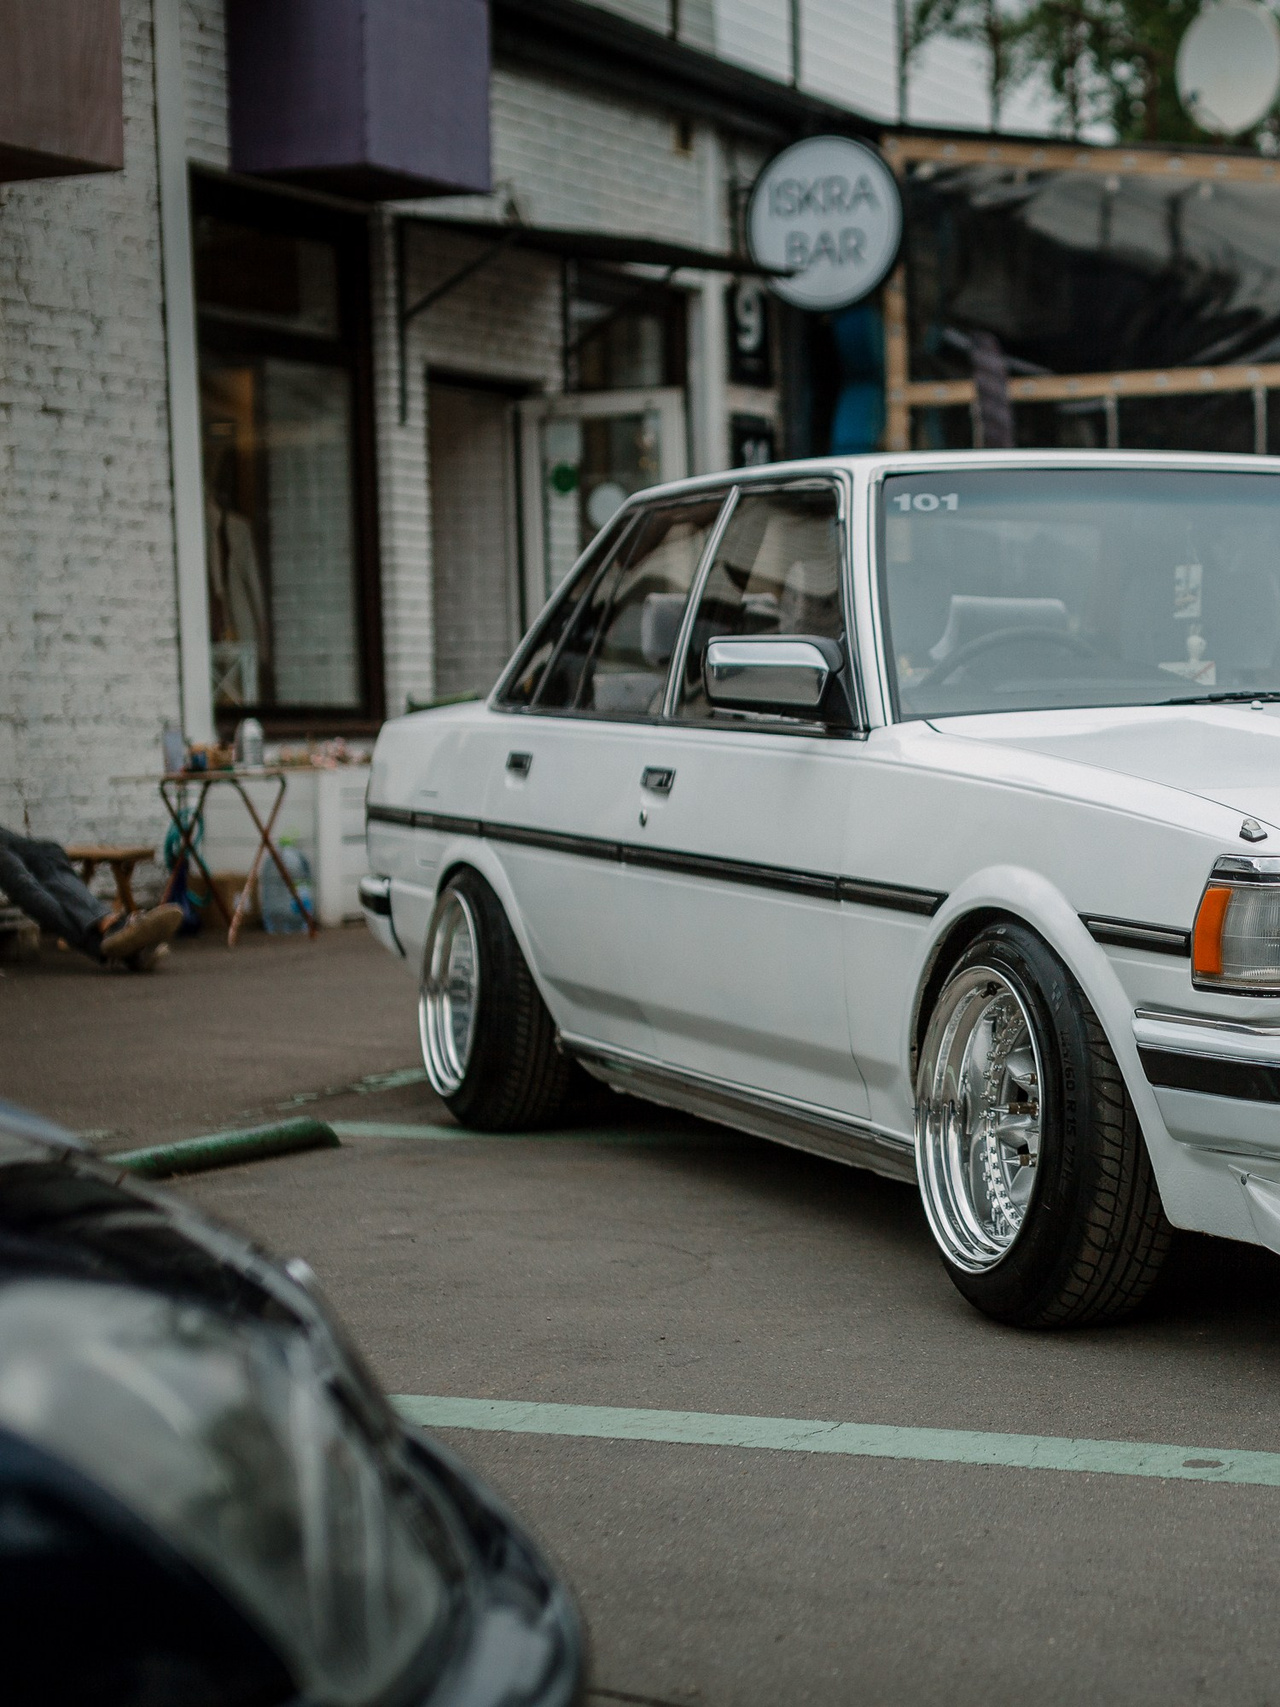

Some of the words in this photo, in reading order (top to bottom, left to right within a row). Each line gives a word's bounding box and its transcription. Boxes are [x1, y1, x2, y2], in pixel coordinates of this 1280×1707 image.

[768, 175, 880, 217] ISKRA
[785, 227, 867, 267] BAR
[893, 492, 958, 511] 101
